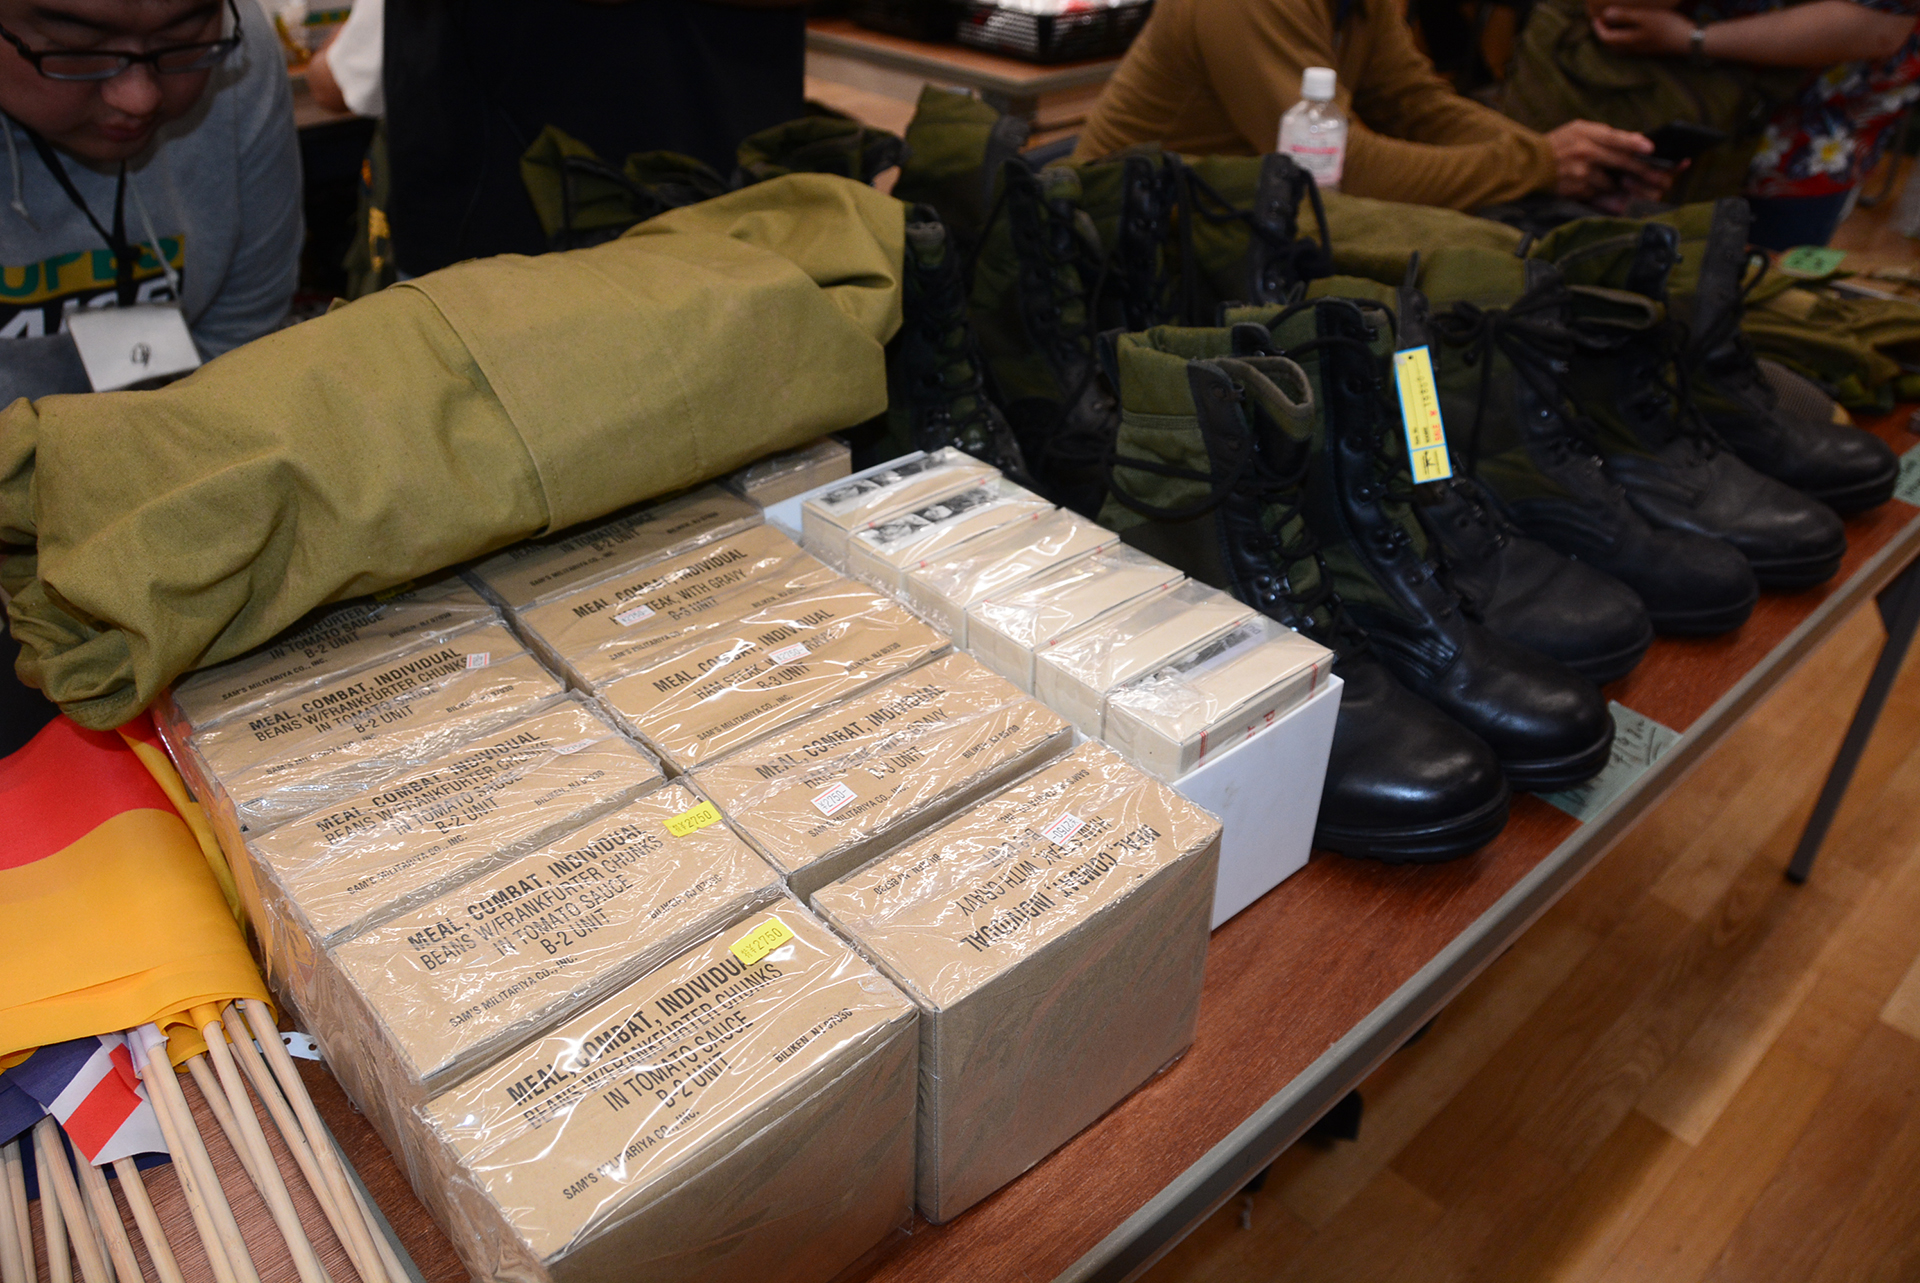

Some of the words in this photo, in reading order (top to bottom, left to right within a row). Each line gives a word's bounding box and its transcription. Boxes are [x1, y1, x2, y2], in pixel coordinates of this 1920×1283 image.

[612, 529, 640, 545] UNIT
[677, 549, 748, 582] INDIVIDUAL
[642, 595, 681, 613] TEAK,
[677, 582, 709, 600] WITH
[707, 569, 748, 589] GRAVY
[667, 604, 692, 621] B-3
[690, 595, 721, 613] UNIT
[269, 646, 284, 660] IN
[288, 627, 340, 655] TOMATO
[342, 612, 385, 636] SAUCE
[304, 643, 329, 659] B-2
[329, 630, 360, 650] UNIT
[609, 649, 632, 661] SAM'S
[631, 634, 670, 652] MILITARIYA
[803, 628, 837, 650] RAVY
[871, 650, 882, 661] NJ
[221, 686, 248, 701] SAM'S
[248, 669, 293, 693] MILITARIYA
[249, 708, 302, 731] MEAL,
[302, 682, 374, 713] COMBAT,
[373, 647, 462, 687] INDIVIDUAL
[652, 670, 702, 693] MEAL,
[778, 661, 811, 681] UNIT
[254, 718, 302, 742] BEANS
[304, 678, 416, 726] W/FRANKFURTER
[419, 656, 468, 683] CHUNKS
[315, 721, 332, 734] IN
[333, 700, 392, 727] TOMATO
[396, 685, 440, 706] SAUCE
[354, 718, 380, 734] B-2
[379, 704, 414, 724] UNIT
[696, 726, 722, 741] SAM'S
[720, 707, 763, 730] MILITARIYA
[775, 693, 794, 704] INC.
[754, 753, 810, 780] MEAL,
[802, 721, 874, 759] COMBAT,
[865, 684, 947, 727] INDIVIDUAL
[266, 761, 294, 776] SAM'S
[449, 731, 541, 776] INDIVIDUAL
[893, 745, 926, 770] UNIT
[324, 816, 377, 846] BEANS
[375, 765, 495, 822] W/FRANKFURTER
[496, 740, 551, 771] CHUNKS
[1067, 768, 1090, 785] SAM'S
[392, 822, 411, 836] IN
[412, 791, 475, 826] TOMATO
[434, 815, 466, 834] B-2
[462, 796, 501, 821] UNIT
[808, 820, 835, 838] SAM'S
[832, 796, 876, 825] MILITARIYA
[820, 788, 848, 811] ¥2750-
[447, 833, 469, 847] INC.
[1053, 817, 1079, 840] ¥2750-
[1033, 836, 1083, 866] SEAK,
[407, 917, 471, 952] MEAL,
[466, 873, 552, 922] COMBAT,
[548, 824, 648, 880] INDIVIDUAL
[1003, 860, 1041, 889] WITH
[419, 933, 477, 971] BEANS
[474, 866, 605, 942] W/FRANKFURTER
[601, 834, 664, 874] CHUNKS
[492, 935, 518, 956] IN
[512, 901, 581, 945] TOMATO
[579, 873, 634, 910] SAUCE
[955, 879, 1008, 917] GRAVY
[540, 930, 574, 955] B-2
[568, 907, 611, 939] UNIT
[449, 1005, 482, 1027] SAM'S
[481, 975, 537, 1011] MILITARIYA
[506, 1063, 577, 1106] MEAL,
[574, 1010, 663, 1070] COMBAT,
[655, 954, 762, 1017] INDIVIDUA
[580, 1002, 721, 1092] W/FRANKFURTER
[715, 963, 783, 1010] CHUNKS
[602, 1086, 630, 1112] IN
[623, 1044, 699, 1097] TOMATO
[694, 1010, 754, 1053] SAUCE
[655, 1078, 693, 1109] B-2
[686, 1051, 732, 1087] UNIT
[562, 1172, 599, 1200] SAM'S
[596, 1136, 657, 1179] MILITARIYA
[675, 1107, 701, 1125] INC.
